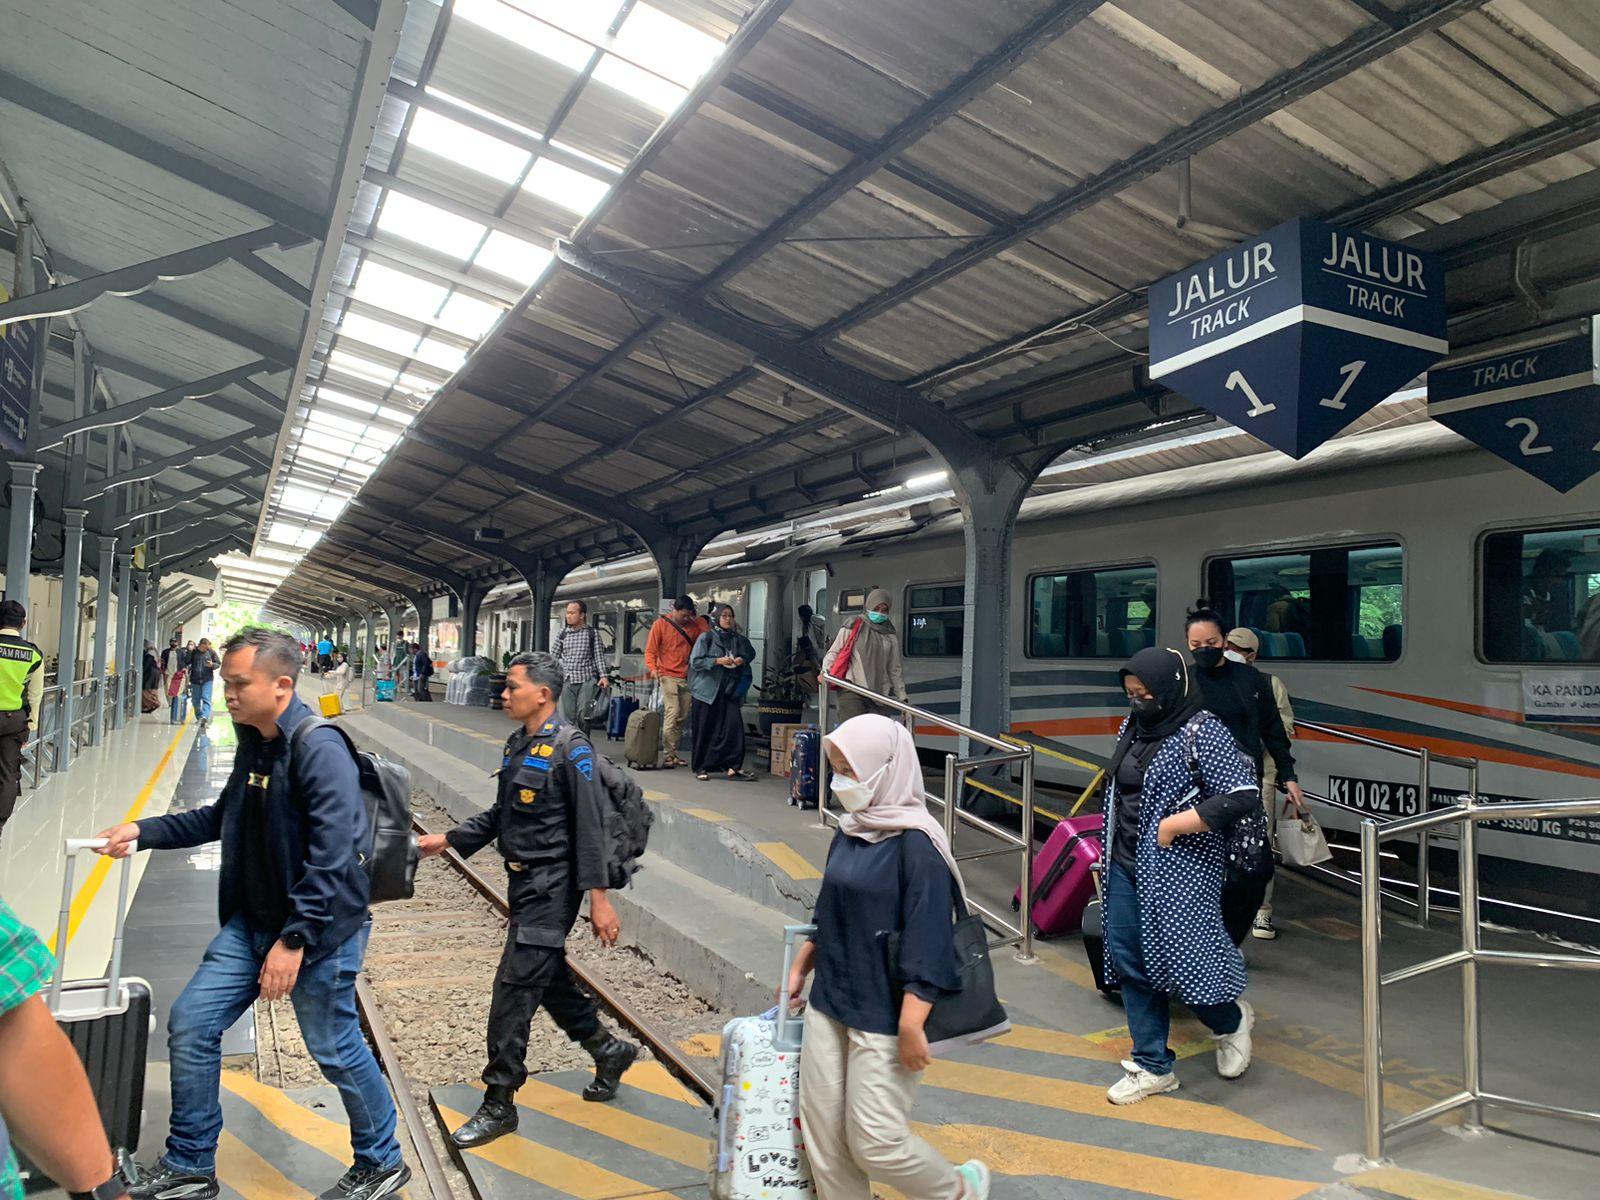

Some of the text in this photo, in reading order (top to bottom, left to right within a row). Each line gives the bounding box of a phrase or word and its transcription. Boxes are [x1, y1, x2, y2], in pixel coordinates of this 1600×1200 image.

[1168, 241, 1277, 318] JALUR
[1322, 231, 1428, 291] JALUR
[1189, 295, 1252, 341] TRACK
[1346, 284, 1407, 319] TRACK
[1318, 359, 1367, 410] 1
[1472, 355, 1539, 388] TRACK
[1224, 369, 1277, 418] 1
[1504, 416, 1554, 456] 2
[1532, 684, 1552, 696] KA
[1330, 778, 1349, 805] K1
[1541, 820, 1561, 835] KG
